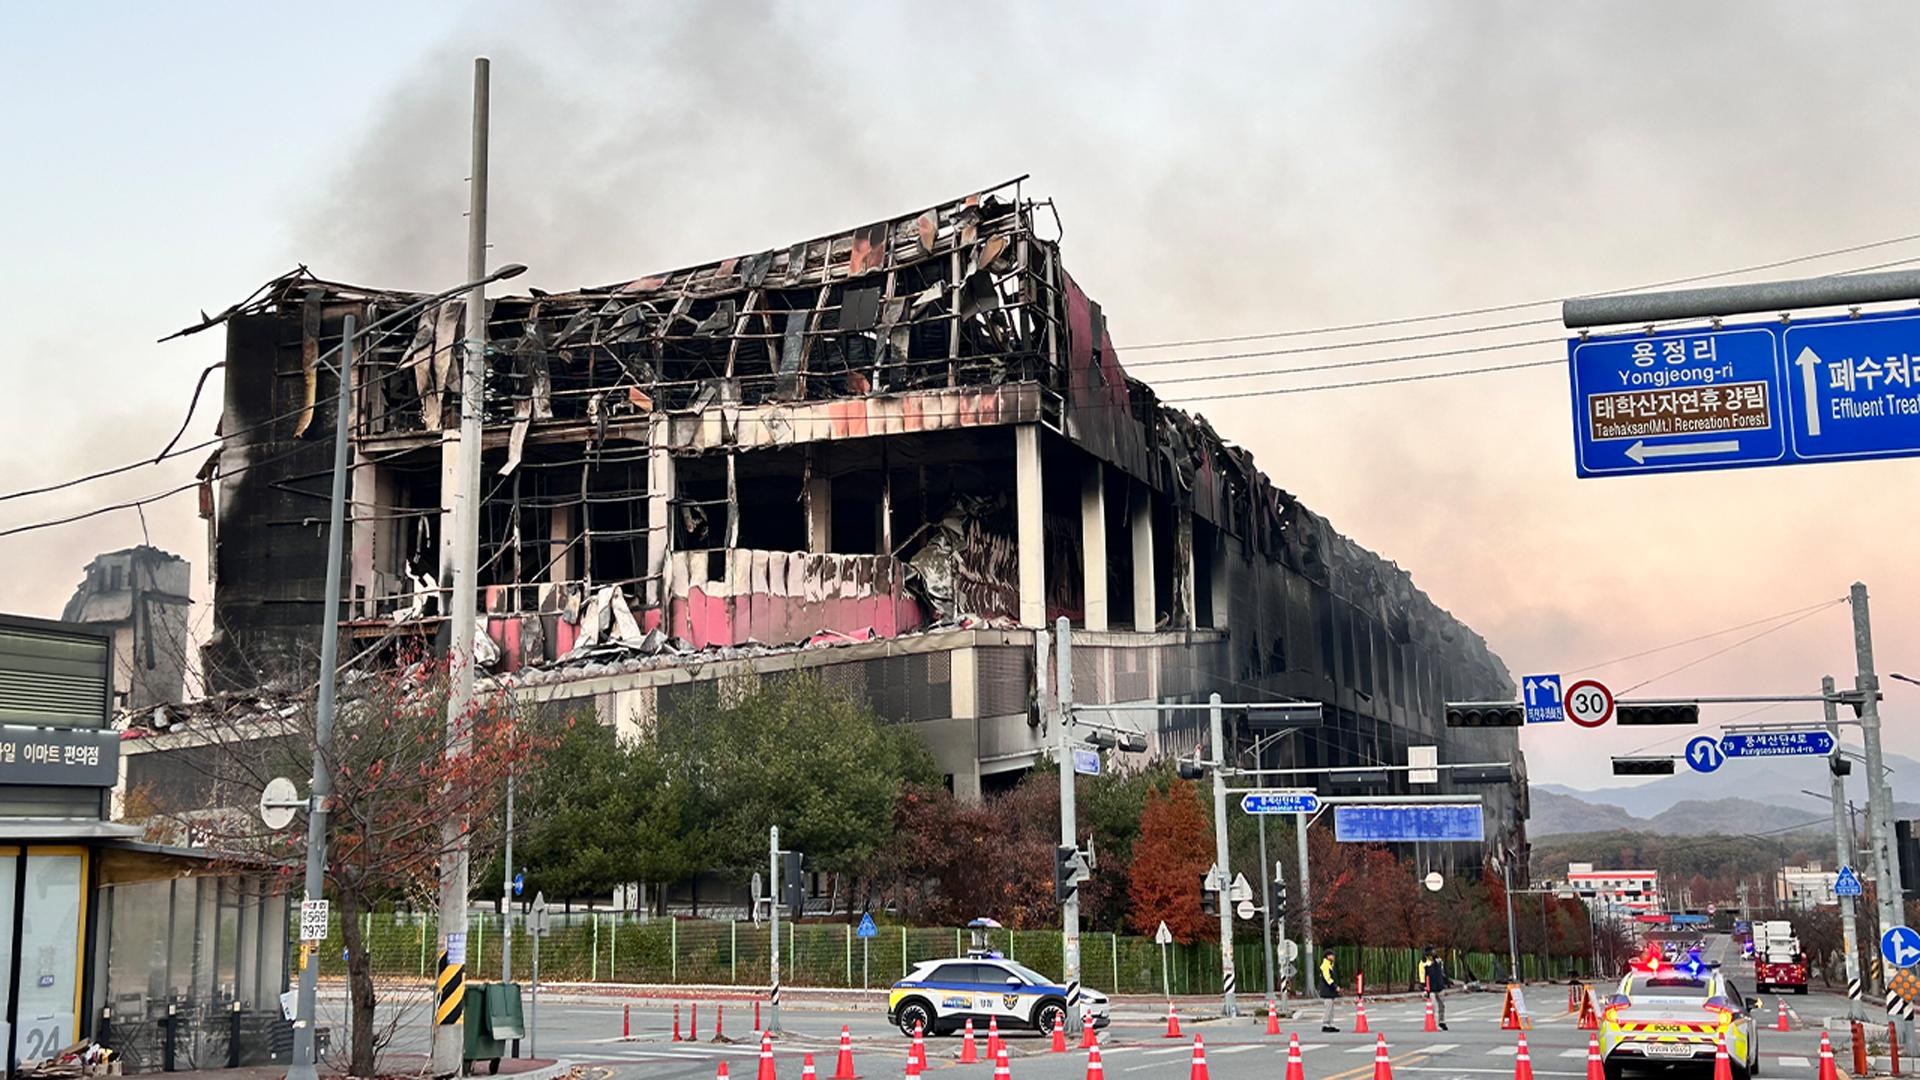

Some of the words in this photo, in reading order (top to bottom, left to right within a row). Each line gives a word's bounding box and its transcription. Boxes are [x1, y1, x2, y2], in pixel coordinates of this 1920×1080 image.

[1618, 362, 1734, 387] Yongjeong-ri
[1595, 385, 1765, 420] 태학산자연휴양림
[1831, 396, 1885, 419] Effluent
[1596, 418, 1672, 437] Taehaksan(Mt.)
[1674, 415, 1731, 432] Recreation
[1732, 412, 1766, 428] Forest
[1575, 693, 1604, 714] 30
[23, 743, 60, 764] 이마트
[64, 745, 99, 766] 편의점
[1654, 1024, 1681, 1032] POLICE
[26, 1025, 60, 1061] 24
